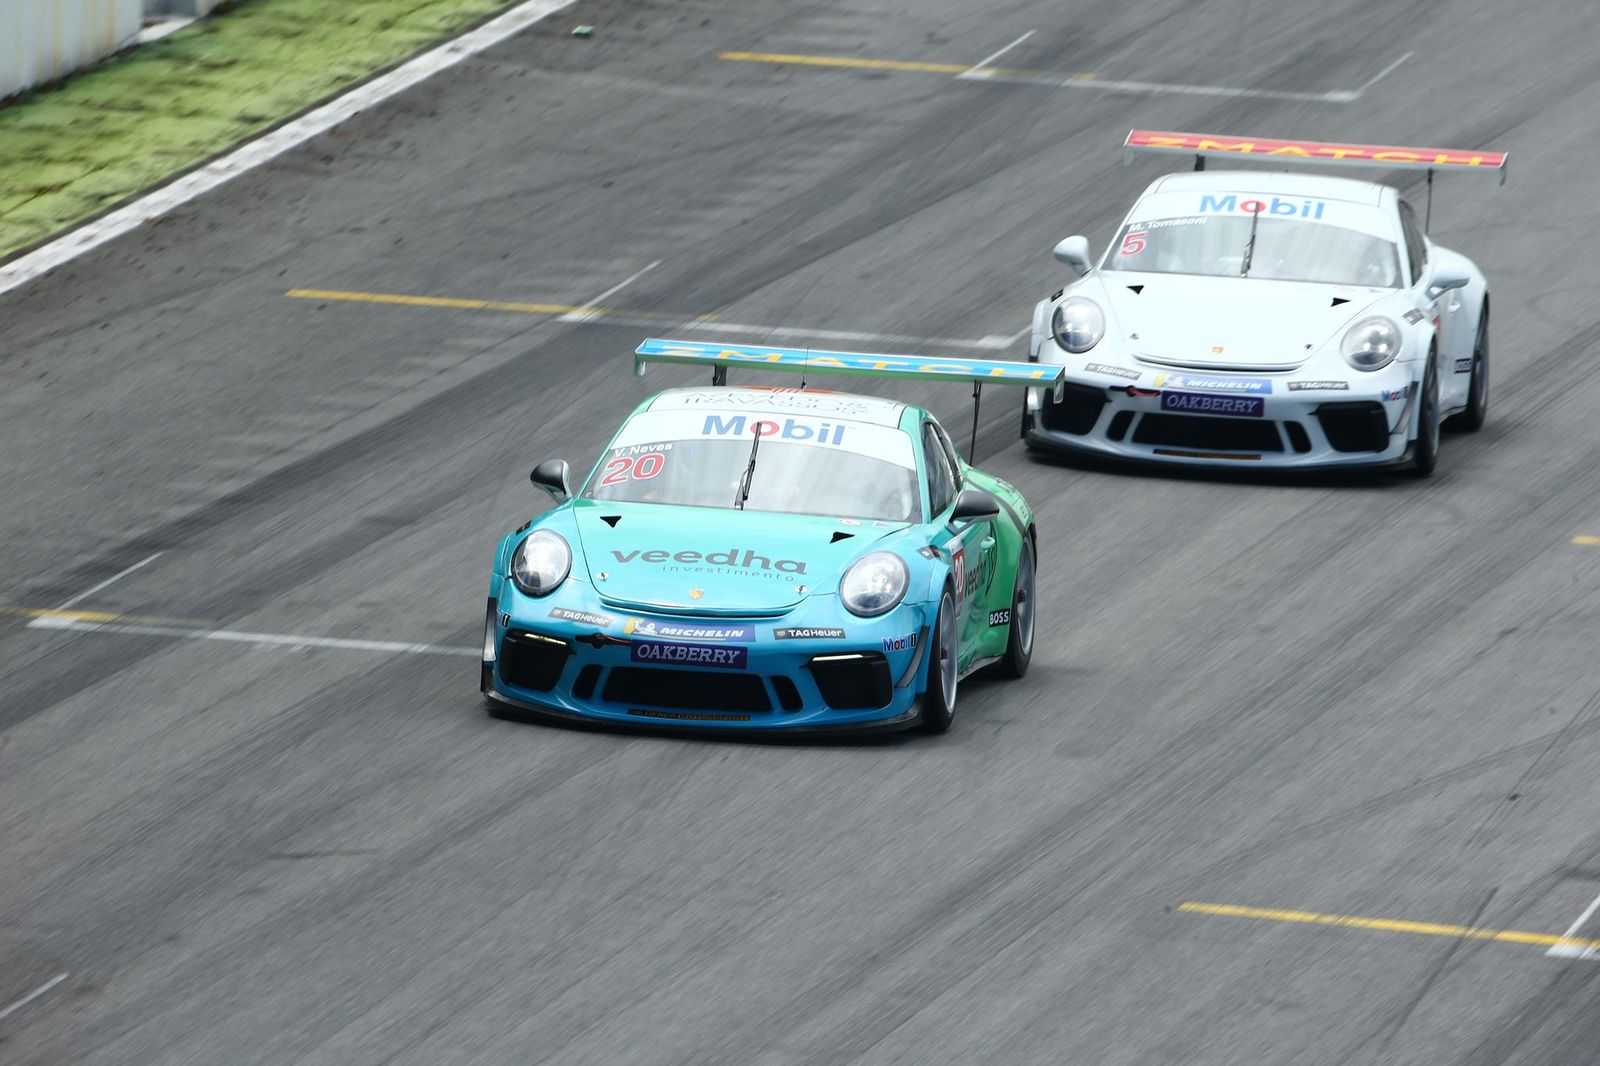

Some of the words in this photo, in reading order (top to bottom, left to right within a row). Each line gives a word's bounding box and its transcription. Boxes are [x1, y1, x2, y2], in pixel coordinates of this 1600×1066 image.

[1199, 195, 1325, 220] Mobil
[1119, 230, 1148, 257] 5
[1186, 378, 1264, 390] MICHELIN
[1165, 394, 1259, 413] OAKBERRY
[702, 415, 846, 446] Mobil
[600, 452, 666, 488] 20
[611, 548, 807, 575] veedha
[989, 610, 1010, 625] BOSS
[660, 626, 745, 639] MICHELIN
[636, 643, 742, 665] OAKBERRY
